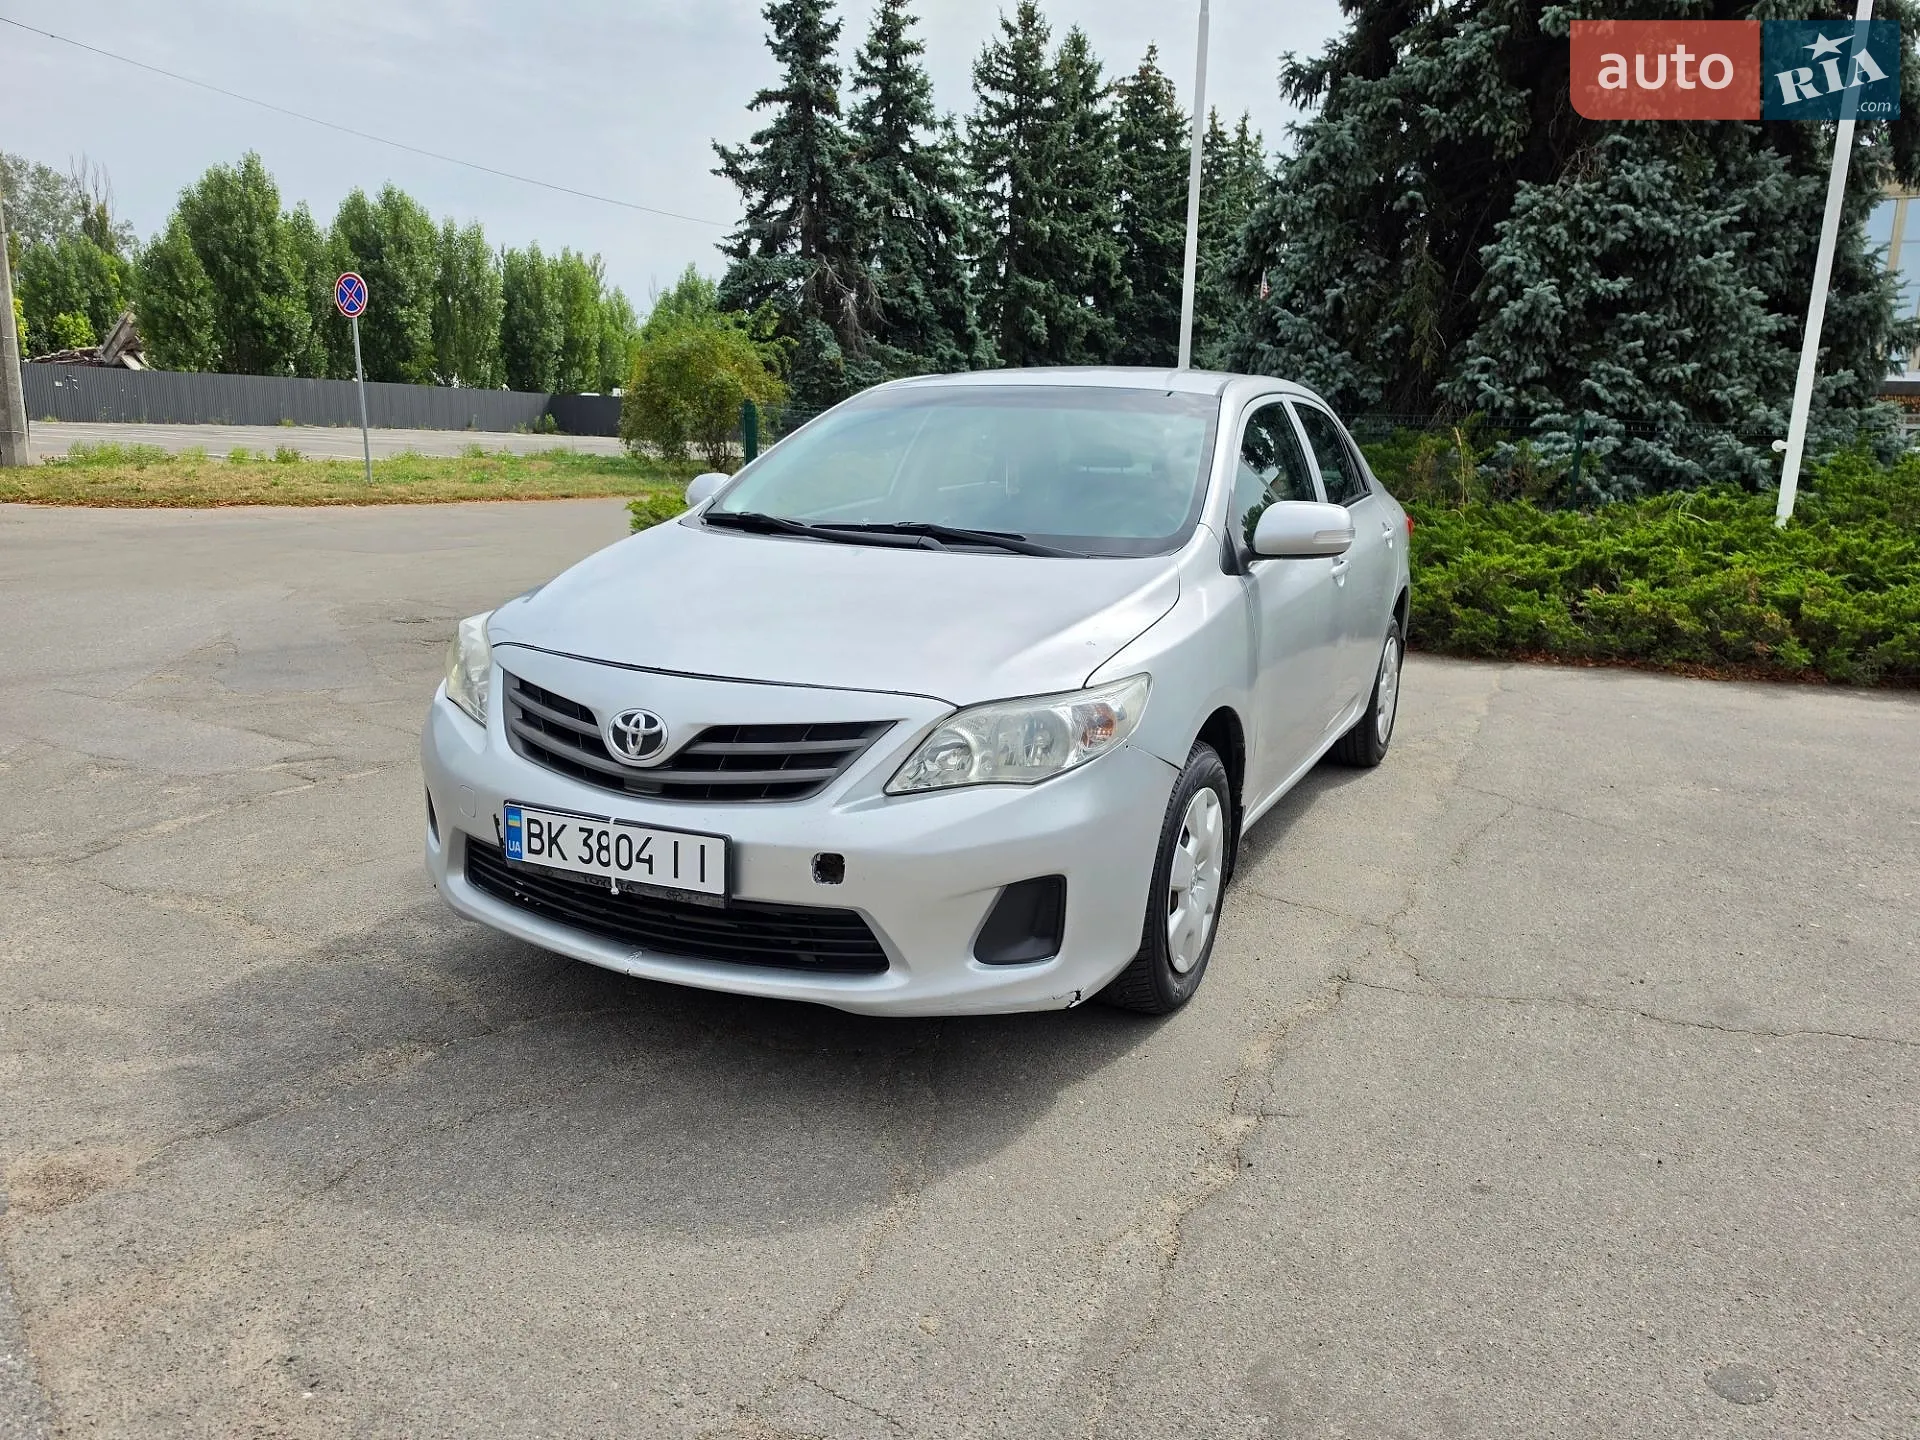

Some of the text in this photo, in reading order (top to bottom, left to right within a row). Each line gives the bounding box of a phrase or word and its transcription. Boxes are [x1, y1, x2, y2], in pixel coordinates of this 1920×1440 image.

[508, 839, 521, 853] UA
[526, 817, 567, 861] BK
[577, 826, 654, 875] 3804
[583, 874, 635, 892] TOYTA
